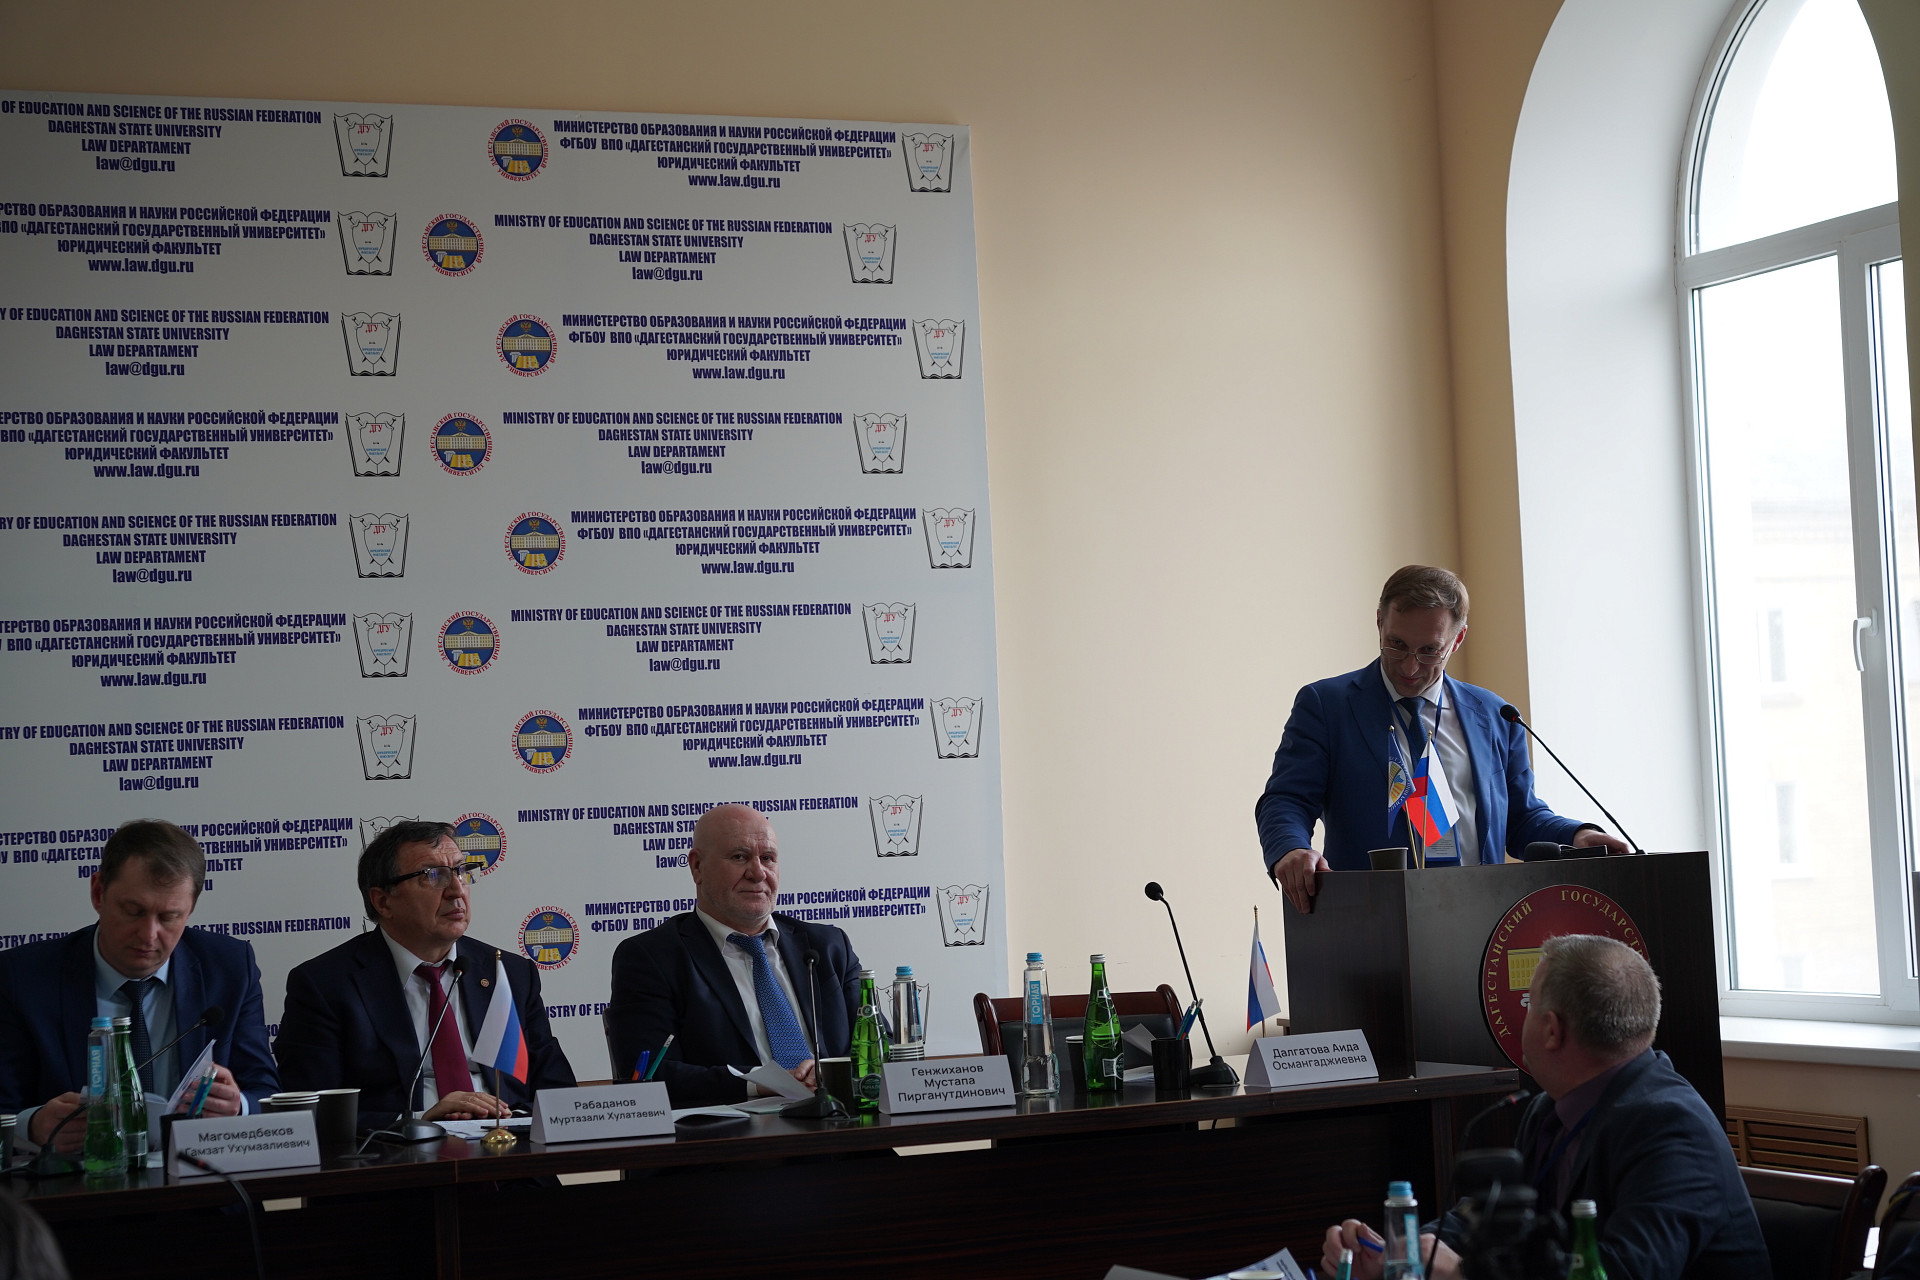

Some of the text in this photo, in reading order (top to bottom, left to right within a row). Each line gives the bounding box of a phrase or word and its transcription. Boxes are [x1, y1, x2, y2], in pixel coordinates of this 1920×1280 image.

[2, 100, 321, 124] OF EDUCATION AND SCIENCE OF THE RUSSIAN FEDERATION
[48, 120, 222, 138] DAGHESTAN STATE UNIVERSITY
[554, 120, 896, 144] МИНИСТЕРСТВО ОБРАЗОВАНИЯ И НАУКИ РОССИЙСКОЙ ФЕДЕРАЦИИ
[82, 139, 191, 154] LAW DEPARTAMENT
[560, 137, 891, 158] ФГБОУ ВПО «ДАГЕСТАНСКИЙ ГОСУДАРСТВЕННЫЙ УНИВЕРСИТЕТ»
[96, 156, 175, 173] law@dgu.ru
[658, 156, 800, 172] ЮРИДИЧЕСКИЙ ФАКУЛЬТЕТ
[688, 174, 780, 189] www.law.dgu.ru
[39, 204, 330, 224] ОБРАЗОВАНИЯ И НАУКИ РОССИЙСКОЙ ФЕДЕРАЦИИ
[494, 214, 832, 233] MINISTRY OF EDUCATION AND SCIENCE OF THE RUSSIAN FEDERATION
[58, 239, 221, 255] ЮРИДИЧЕСКИЙ ФАКУЛЬТЕТ
[590, 233, 743, 248] DAGHESTAN STATE UNIVERSITY
[619, 250, 716, 263] LAW DEPARTAMENT
[88, 258, 194, 274] www.law.dgu.ru
[632, 267, 702, 282] law@dgu.ru
[106, 362, 184, 377] law@dgu.ru
[94, 463, 199, 478] www.law.dgu.ru
[571, 506, 916, 523] МИНИСТЕРСТВО ОБРАЗОВАНИЯ И НАУКИ РОССИЙСКОЙ ФЕДЕРАЦИИ
[63, 532, 237, 546] DAGHESTAN STATE UNIVERSITY
[578, 523, 912, 540] ФГБОУ ВПО «ДАГЕСТАНСКИЙ ГОСУДАРСТВЕННЫЙ УНИВЕРСИТЕТ»
[676, 540, 820, 556] ЮРИДИЧЕСКИЙ ФАКУЛЬТЕТ
[96, 550, 206, 564] LAW DEPARTAMENT
[701, 560, 794, 574] www.law.dgu.ru
[113, 568, 192, 584] law@dgu.ru
[511, 603, 851, 622] MINISTRY OF EDUCATION AND SCIENCE OF THE RUSSIAN FEDERATION
[607, 622, 762, 636] DAGHESTAN STATE UNIVERSITY
[636, 639, 734, 652] LAW DEPARTAMENT
[72, 650, 236, 669] ЮРИДИЧЕСКИЙ ФАКУЛЬТЕТ
[649, 658, 720, 672] law@dgu.ru
[100, 671, 206, 687] www.law.dgu.ru
[579, 698, 924, 720] МИНИСТЕРСТВО ОБРАЗОВАНИЯ И НАУКИ РОССИЙСКОЙ ФЕДЕРАЦИИ
[585, 715, 919, 737] ФГБОУ ВПО «ДАГЕСТАНСКИЙ ГОСУДАРСТВЕННЫЙ УНИВЕРСИТЕТ»
[70, 737, 244, 755] DAGHESTAN STATE UNIVERSITY
[683, 734, 827, 752] ЮРИДИЧЕСКИЙ ФАКУЛЬТЕТ
[103, 756, 213, 772] LAW DEPARTAMENT
[708, 753, 801, 768] www.law.dgu.ru
[120, 776, 198, 791] law@dgu.ru
[1487, 901, 1532, 1038] ДАГЕСТАНСКИЙ
[1031, 983, 1041, 1018] ГОРНАЯ
[1272, 1041, 1360, 1059] Далгатова Аида
[92, 1050, 101, 1088] ГОРНАЯ
[1272, 1053, 1368, 1071] Османгаджиевна
[911, 1064, 984, 1077] Генжиханов
[924, 1076, 976, 1089] Мустапа
[898, 1087, 1006, 1103] Пирганутдинович
[574, 1099, 637, 1111] Рабаданов
[550, 1110, 666, 1126] Муртазали Хулатаевич
[198, 1126, 294, 1143] Магомедбеков
[228, 1140, 311, 1155] Ухумаалиевич
